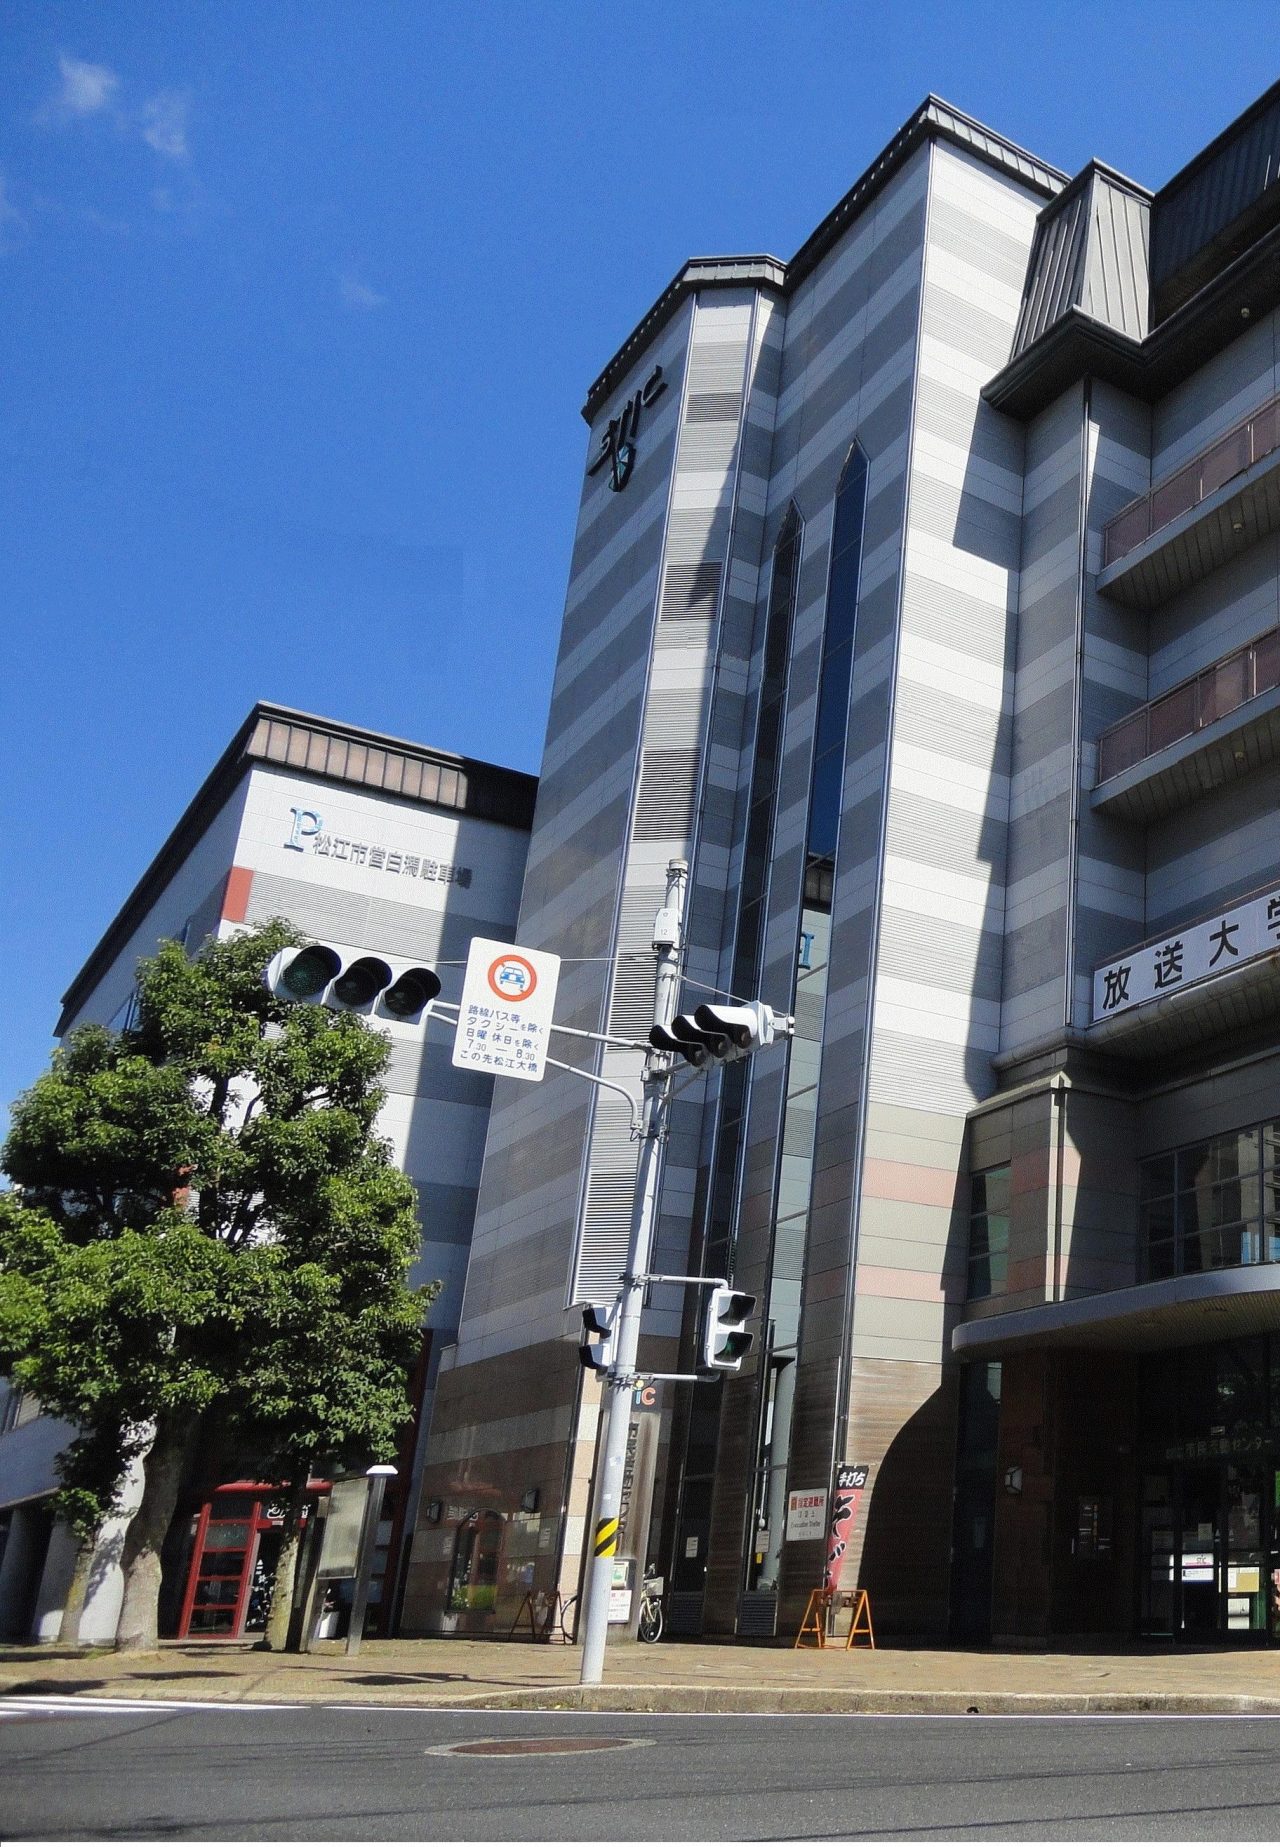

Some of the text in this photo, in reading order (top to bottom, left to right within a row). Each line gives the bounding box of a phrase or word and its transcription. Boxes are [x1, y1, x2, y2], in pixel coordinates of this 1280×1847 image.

[468, 1004, 520, 1024] 路線バス等
[460, 1049, 538, 1073] この先松江大橋
[838, 1471, 866, 1488] 手打ち
